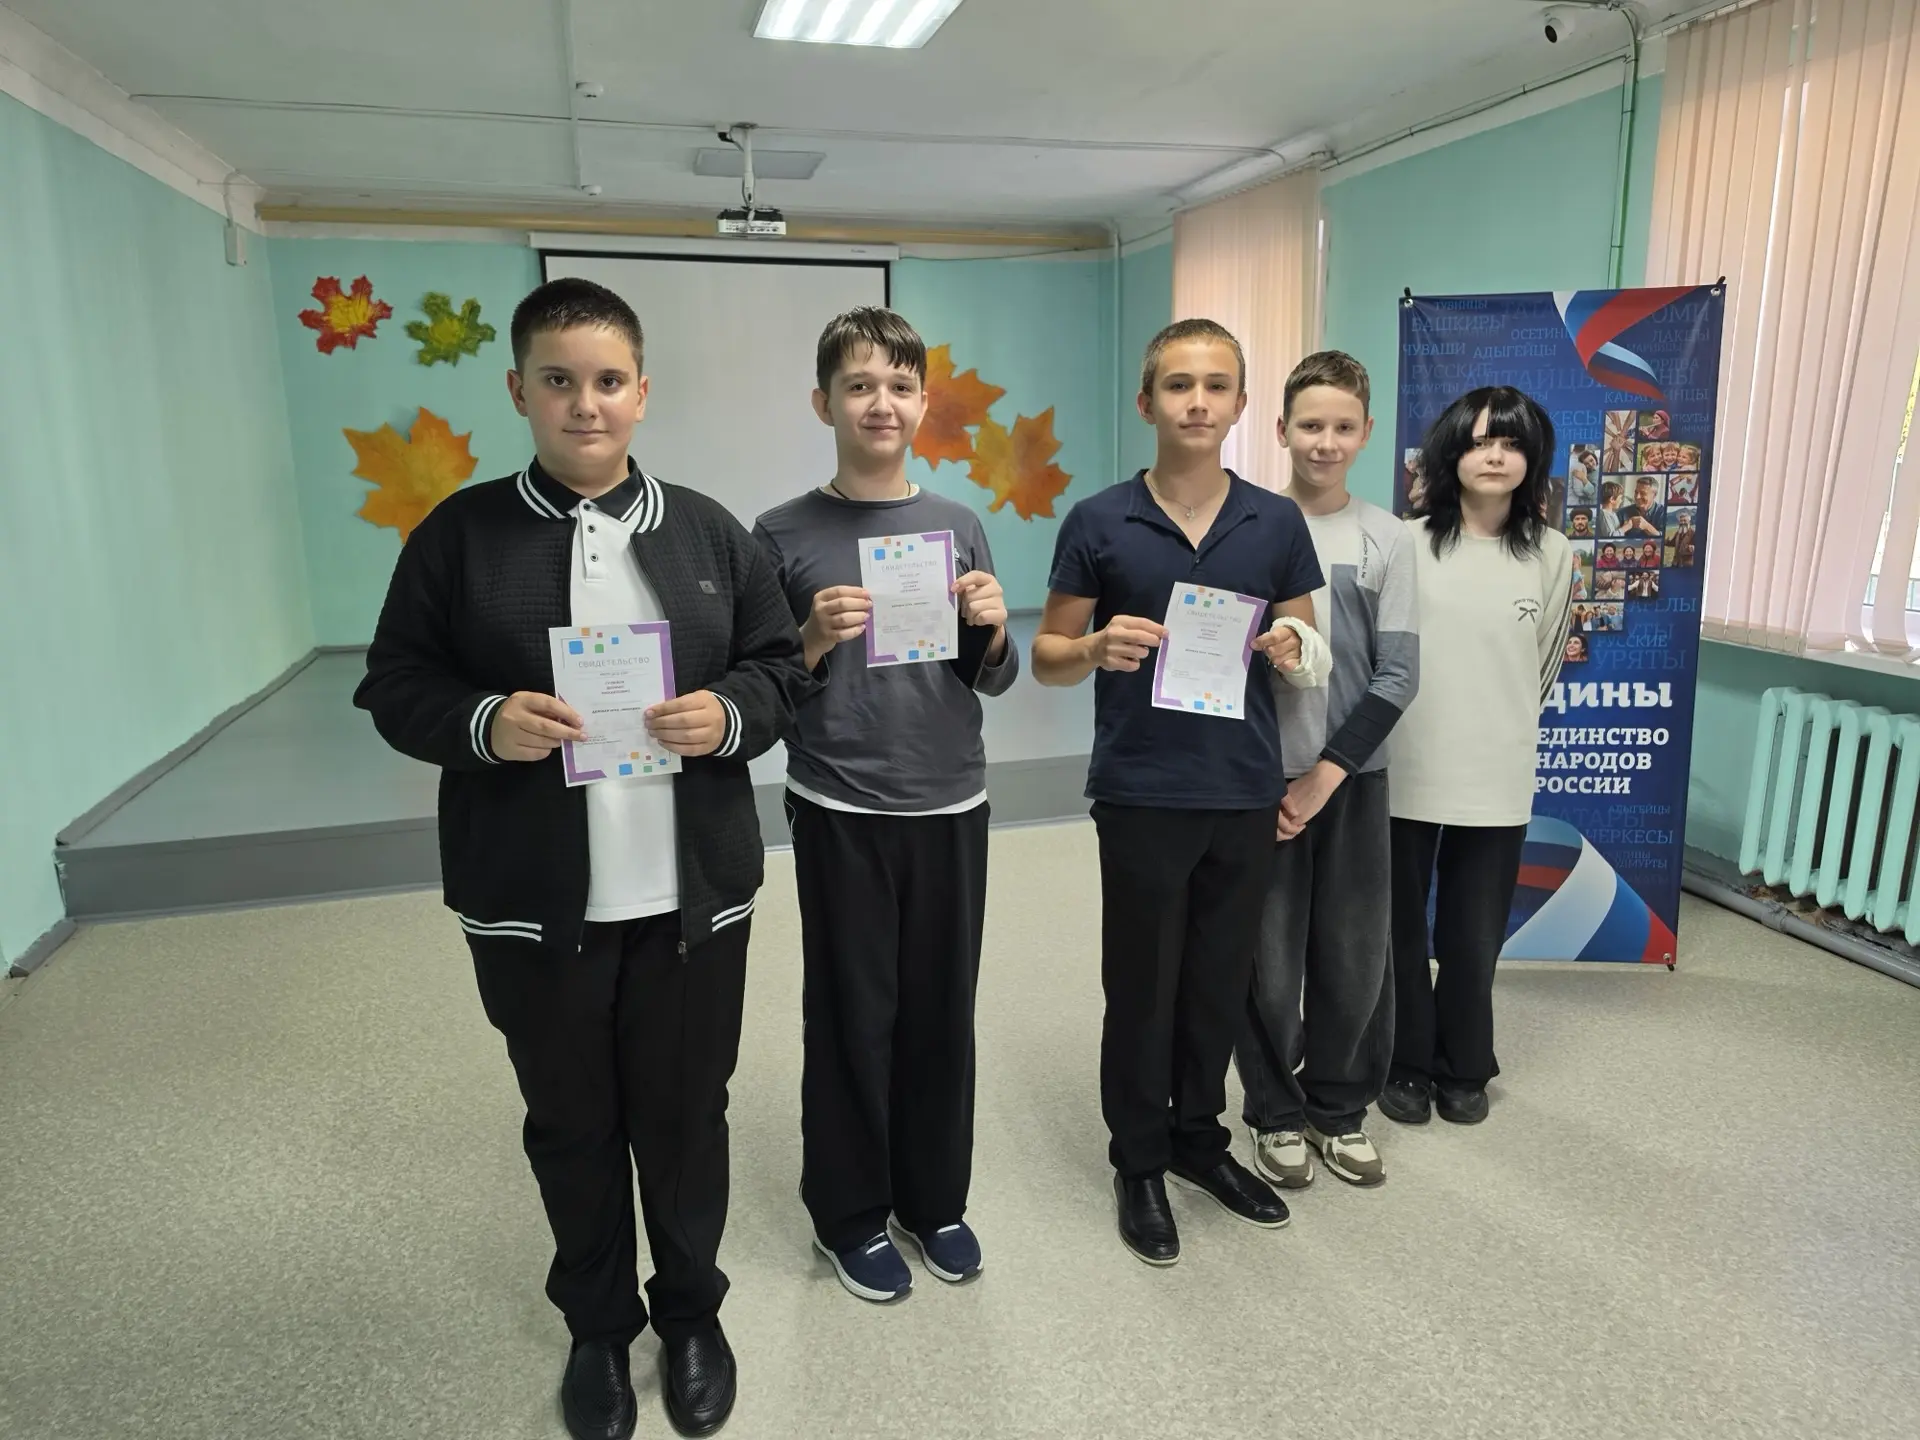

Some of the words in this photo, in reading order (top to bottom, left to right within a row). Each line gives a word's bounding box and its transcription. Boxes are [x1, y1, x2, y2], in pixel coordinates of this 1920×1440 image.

[1411, 314, 1506, 332] БАШКИРЫ
[1403, 343, 1466, 356] ЧУВАШИ
[1473, 343, 1557, 361] АДЫГЕЙЦЫ
[578, 656, 650, 669] СВИДЕТЕЛЬСТВО
[1537, 727, 1670, 749] ЕДИНСТВО
[1536, 752, 1652, 773] НАРОДОВ
[1534, 776, 1631, 794] РОССИИ
[1586, 829, 1674, 844] ЧЕРКЕСЫ
